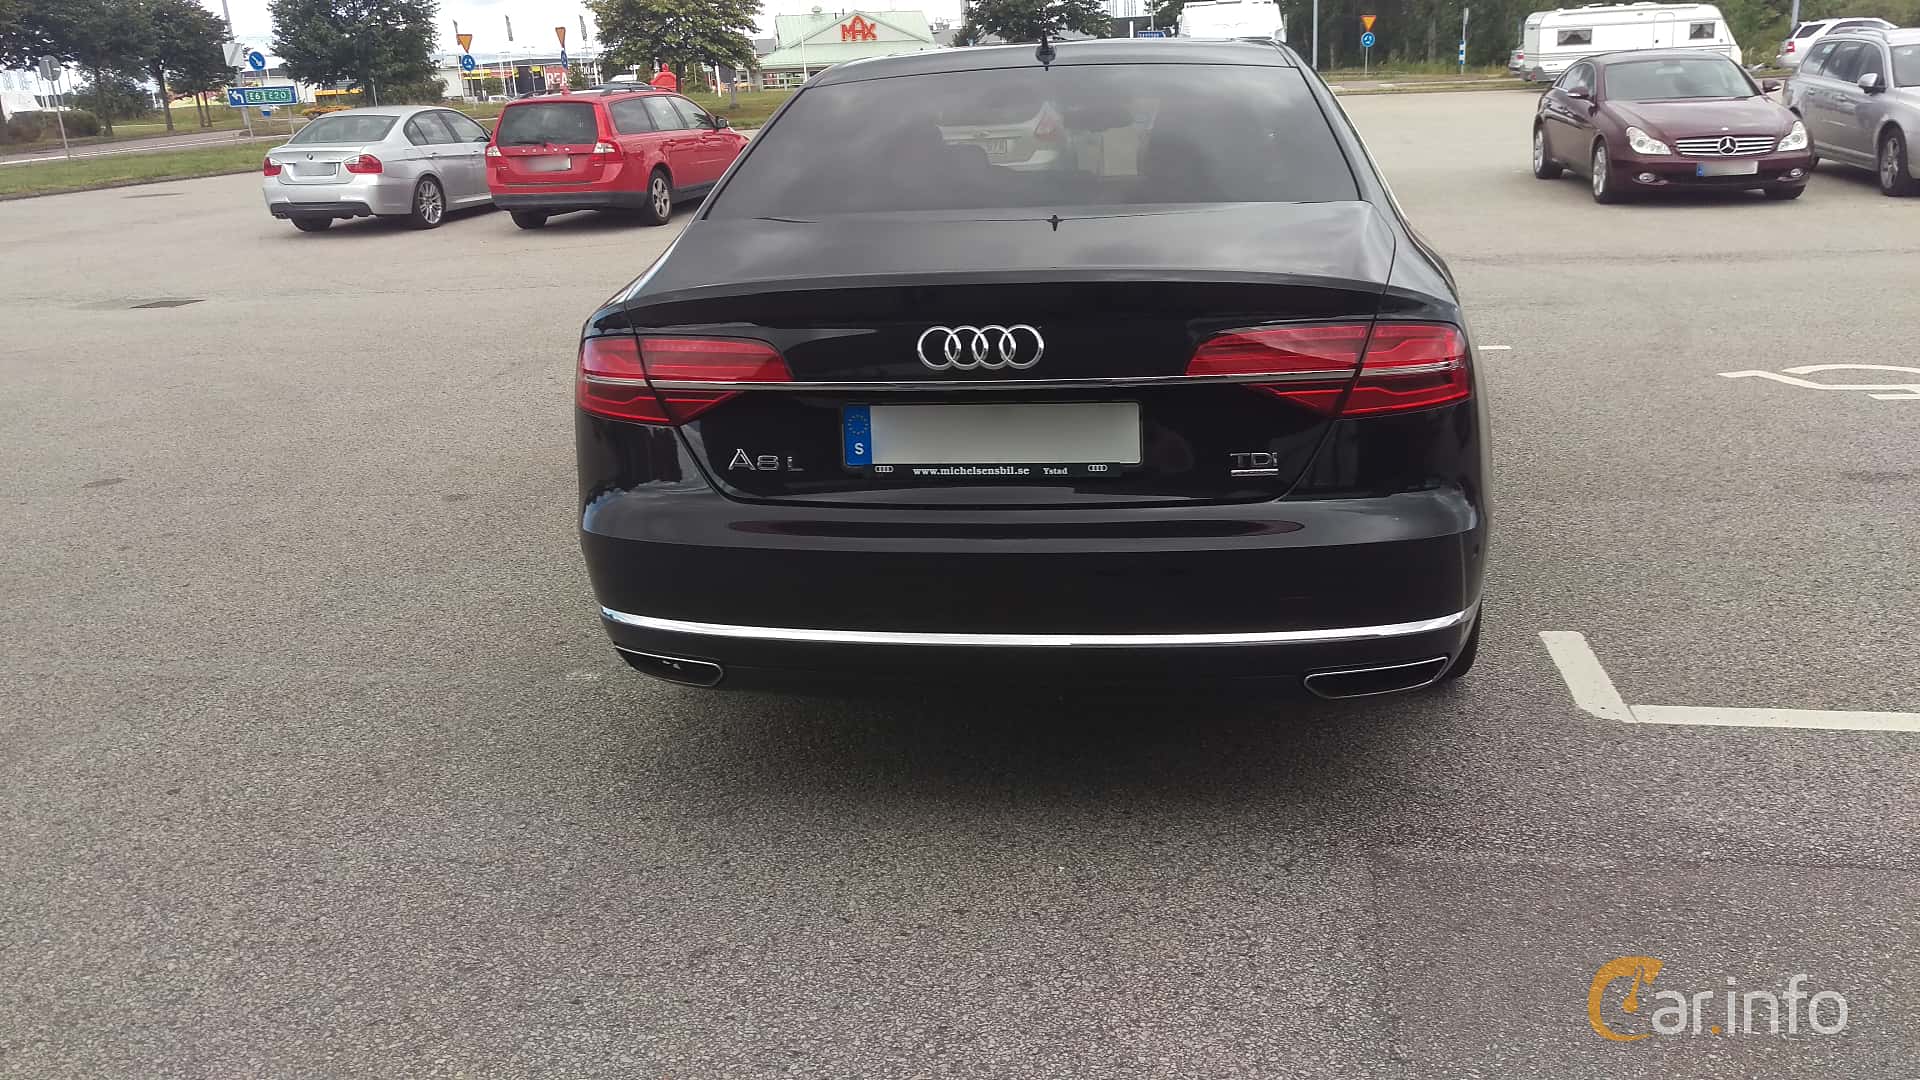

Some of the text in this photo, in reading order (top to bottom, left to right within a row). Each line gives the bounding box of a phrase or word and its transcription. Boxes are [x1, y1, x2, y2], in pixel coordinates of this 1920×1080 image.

[841, 15, 877, 41] MAX
[249, 91, 287, 100] E6 E20
[855, 442, 865, 455] S
[912, 465, 1069, 476] www.michelsensbil.se Ystad
